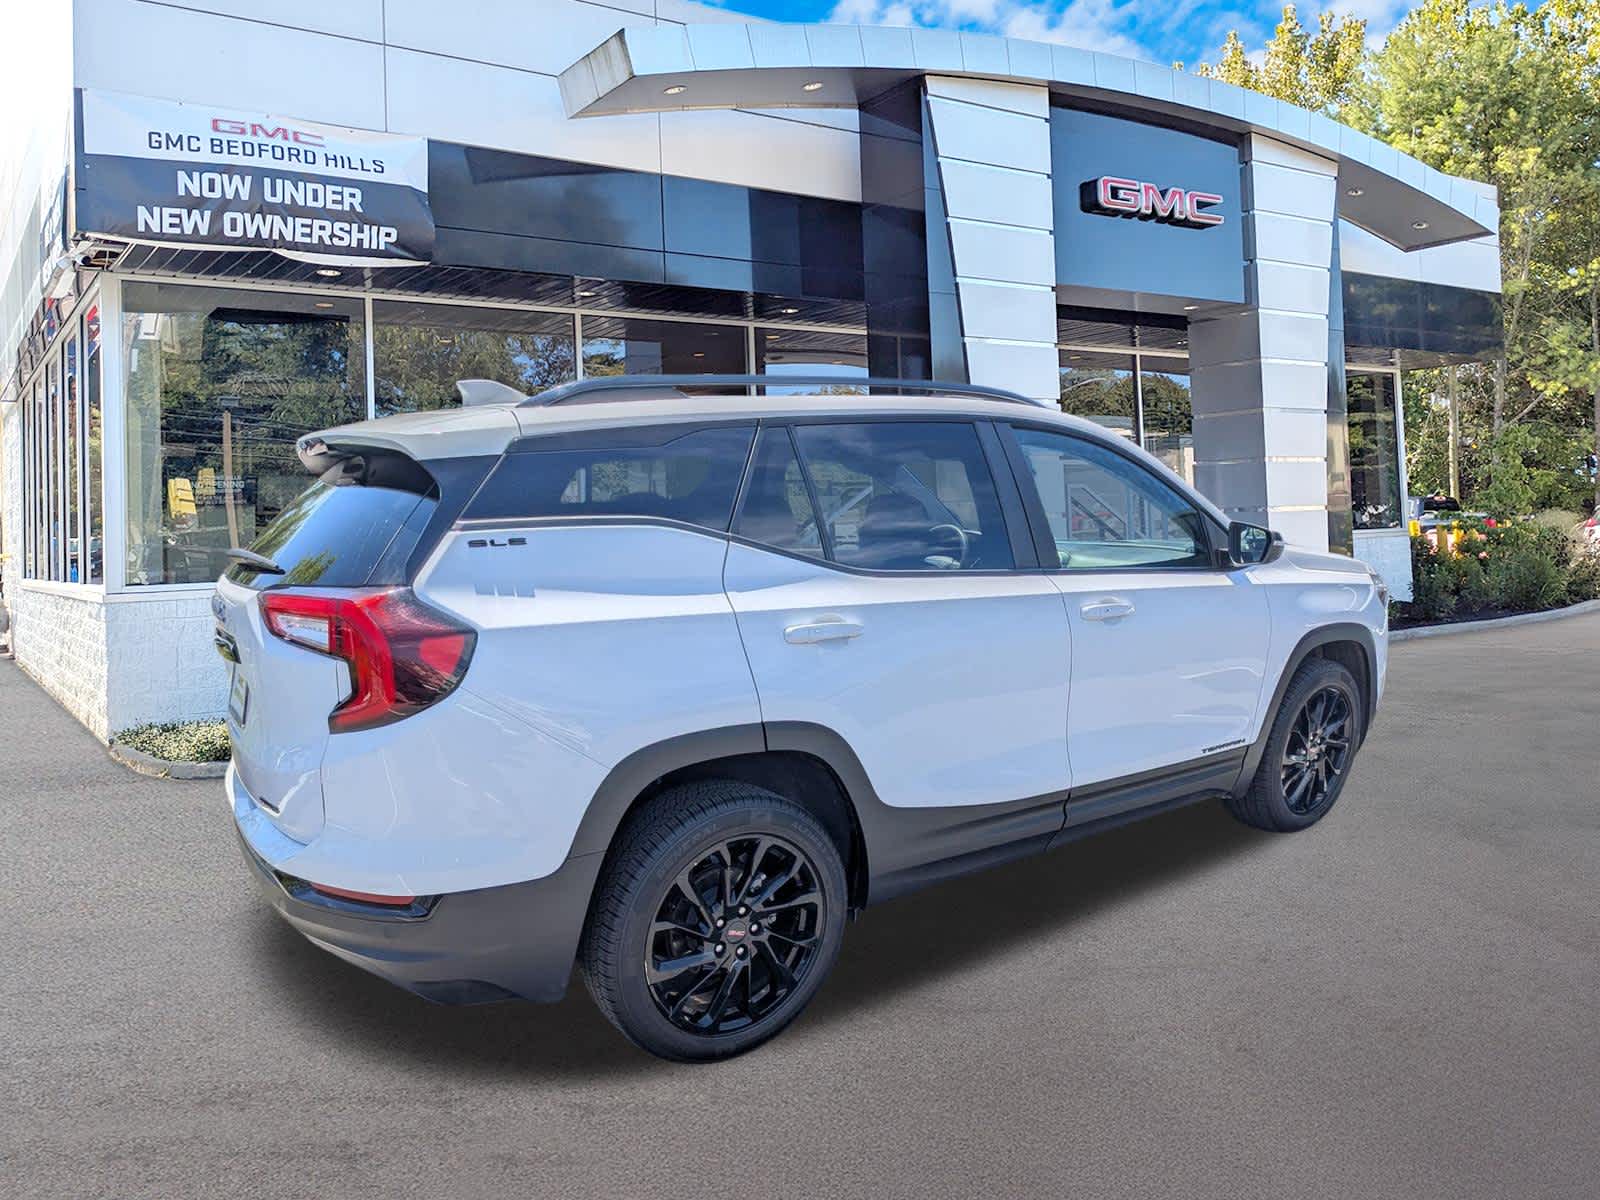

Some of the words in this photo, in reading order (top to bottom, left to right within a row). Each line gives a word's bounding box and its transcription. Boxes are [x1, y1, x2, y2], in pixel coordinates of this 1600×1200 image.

[148, 132, 201, 152] GMC
[210, 138, 316, 164] BEDFORD
[325, 154, 385, 174] HILLS
[211, 118, 325, 147] GMC
[176, 171, 252, 200] NOW
[263, 177, 363, 212] UNDER
[1097, 175, 1224, 225] GMC
[136, 205, 211, 235] NEW
[223, 211, 398, 249] OWNERSHIP
